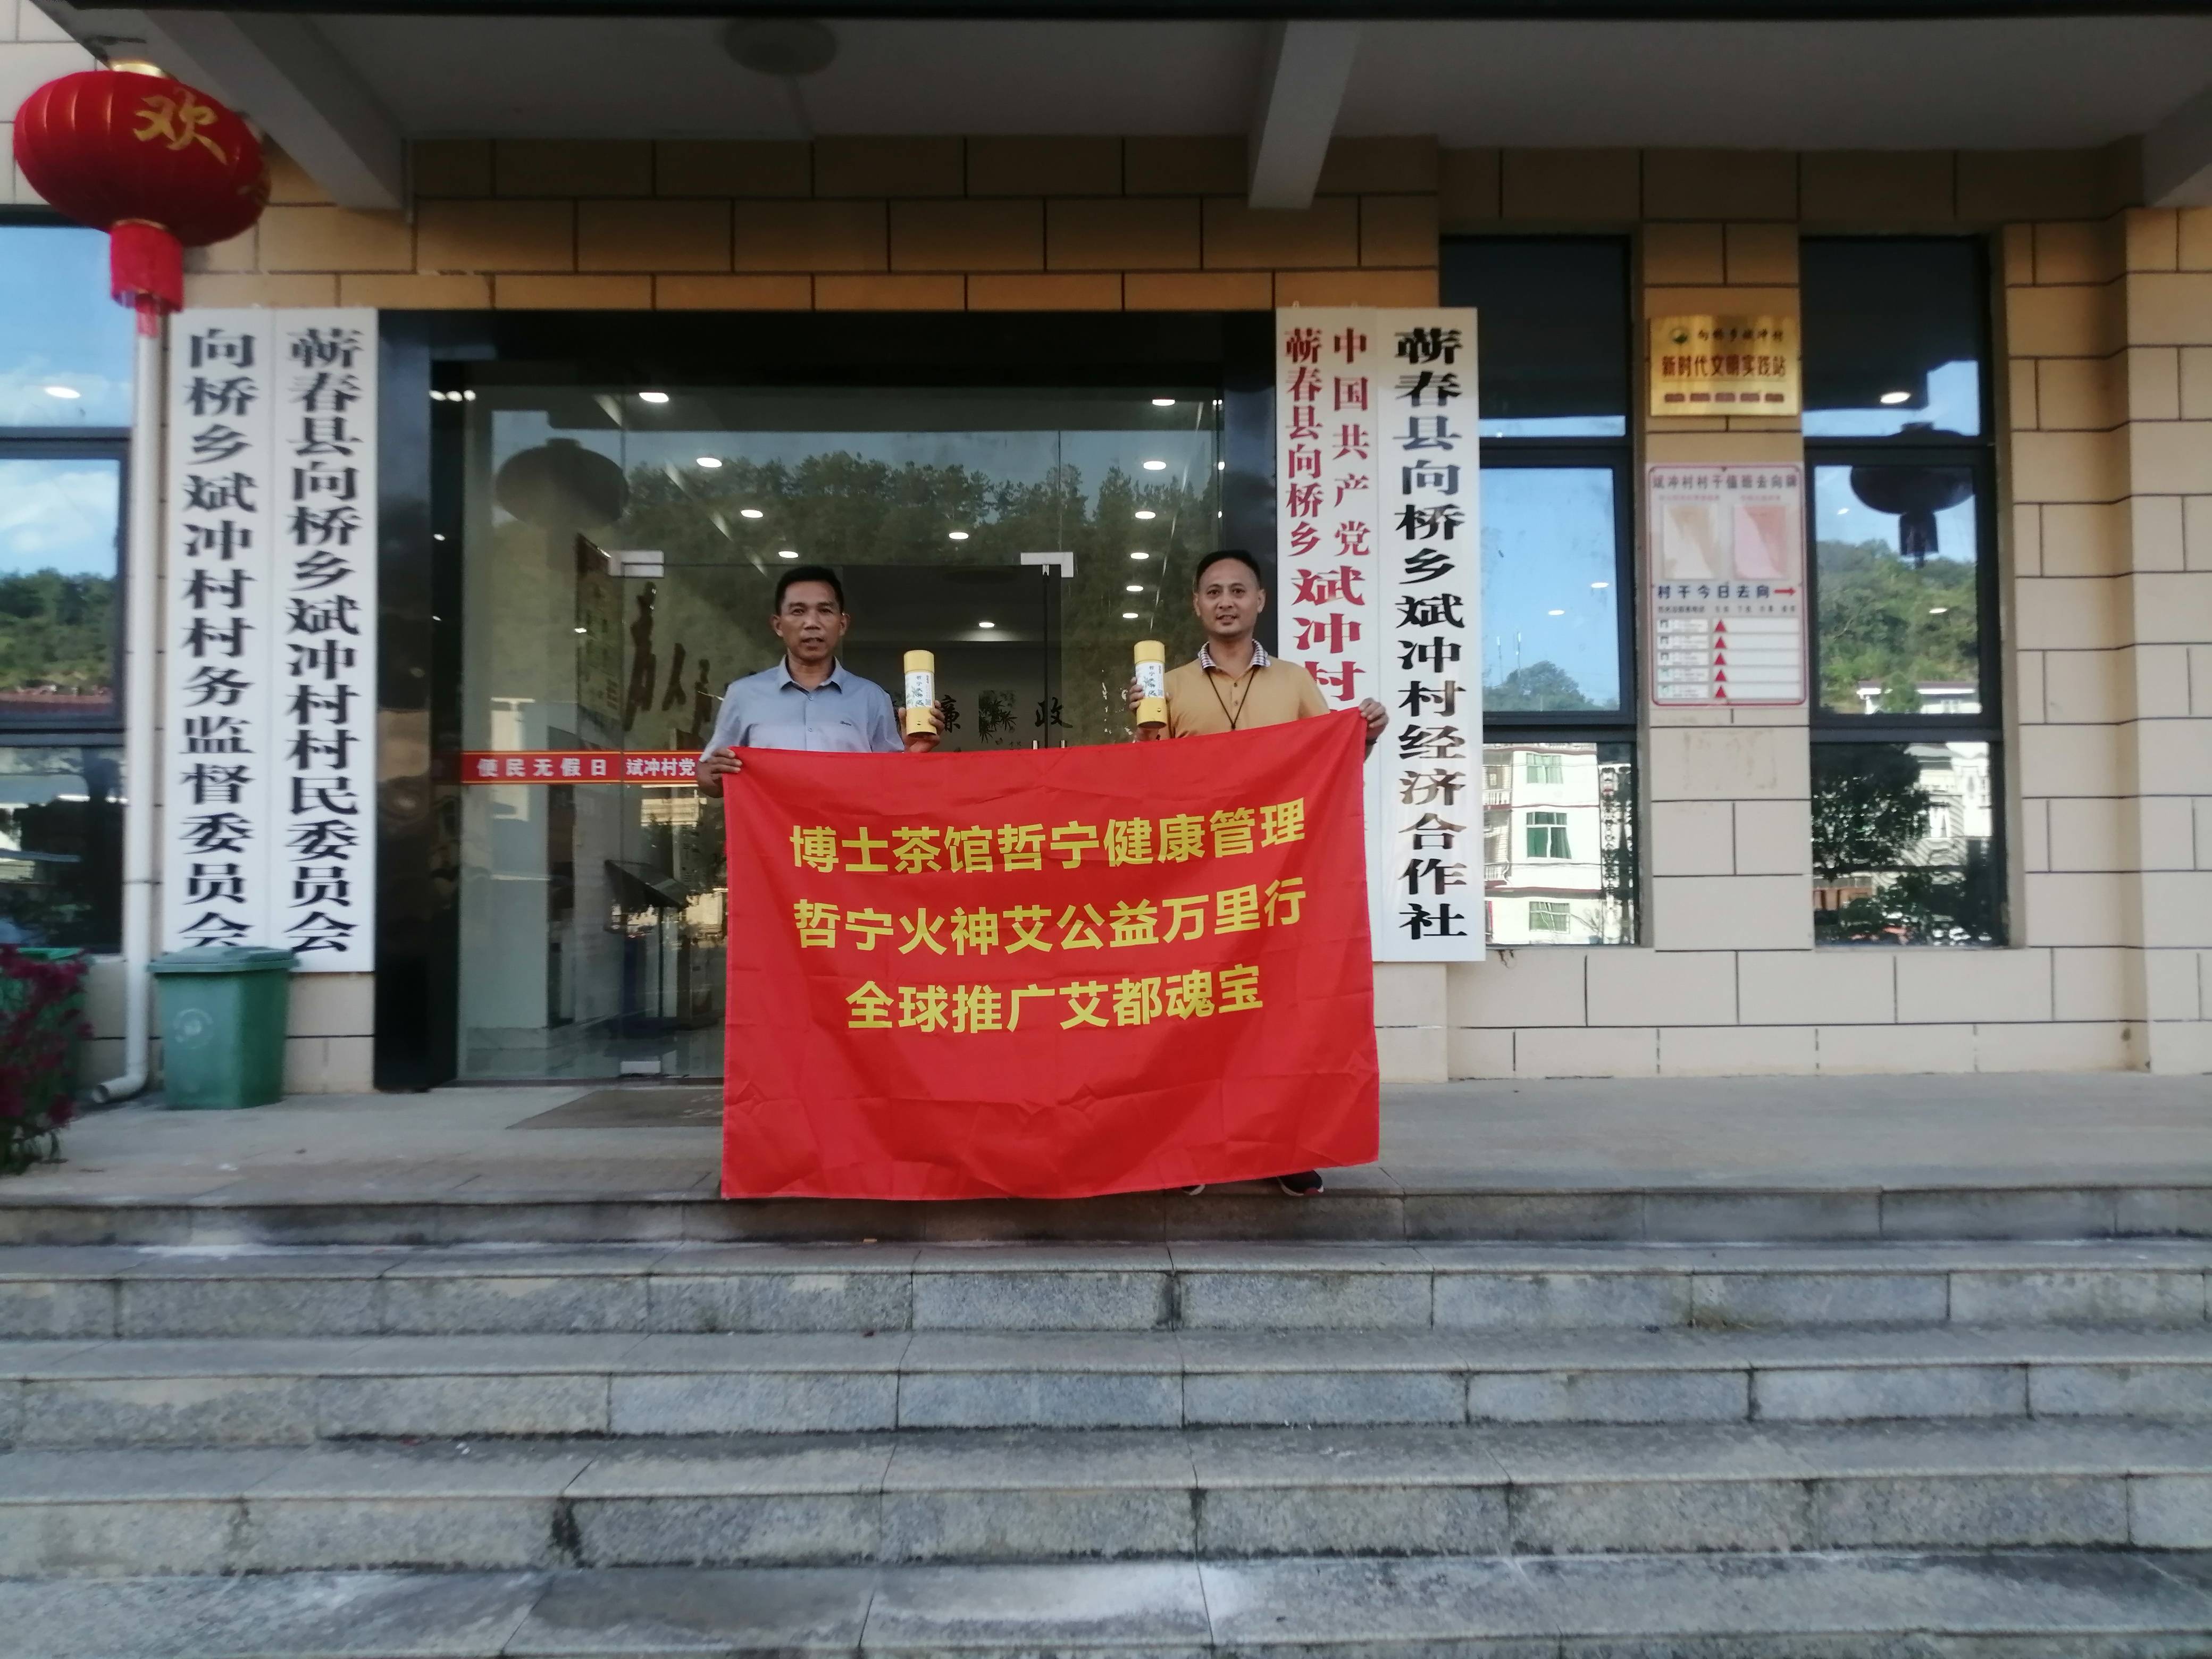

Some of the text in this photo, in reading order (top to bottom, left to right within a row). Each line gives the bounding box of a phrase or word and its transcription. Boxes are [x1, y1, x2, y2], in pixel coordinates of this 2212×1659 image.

[133, 88, 228, 165] 欢
[1285, 326, 1323, 557] 蕲春县向桥乡
[1333, 326, 1371, 557] 中国共产党
[179, 328, 259, 947] 向桥乡斌冲村村务监督委员会
[286, 328, 363, 953] 蕲春县向桥乡斌冲村村民委员会
[1291, 565, 1366, 711] 斌冲村
[1393, 326, 1468, 940] 蕲春县向桥乡斌冲村经济合作社
[1657, 585, 1770, 599] 村干今日去向
[477, 757, 607, 778] 便民无假日
[790, 798, 1305, 875] 博士茶馆哲宁健康管理
[793, 876, 1306, 956] 哲宁火神艾公益万里行
[845, 963, 1263, 1033] 全球推广艾都魂宝
